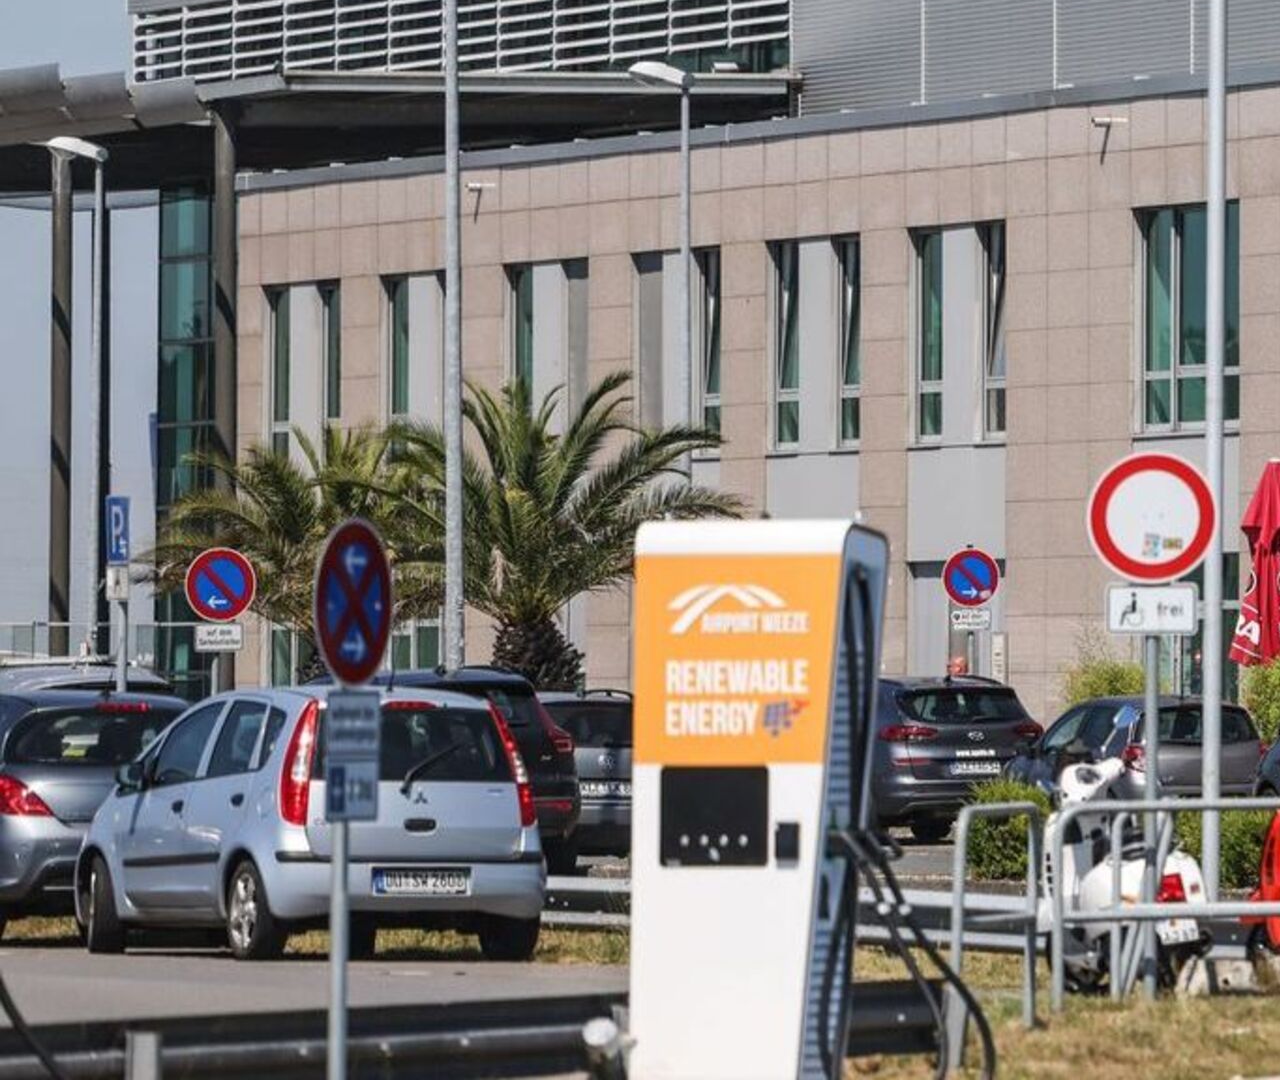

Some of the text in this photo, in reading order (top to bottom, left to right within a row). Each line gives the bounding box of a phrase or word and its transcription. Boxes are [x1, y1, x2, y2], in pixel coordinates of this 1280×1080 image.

[111, 505, 124, 553] P
[762, 611, 809, 633] WEEZE
[1157, 601, 1184, 616] frei
[665, 659, 809, 694] RENEWABLE
[665, 701, 759, 736] ENERGY
